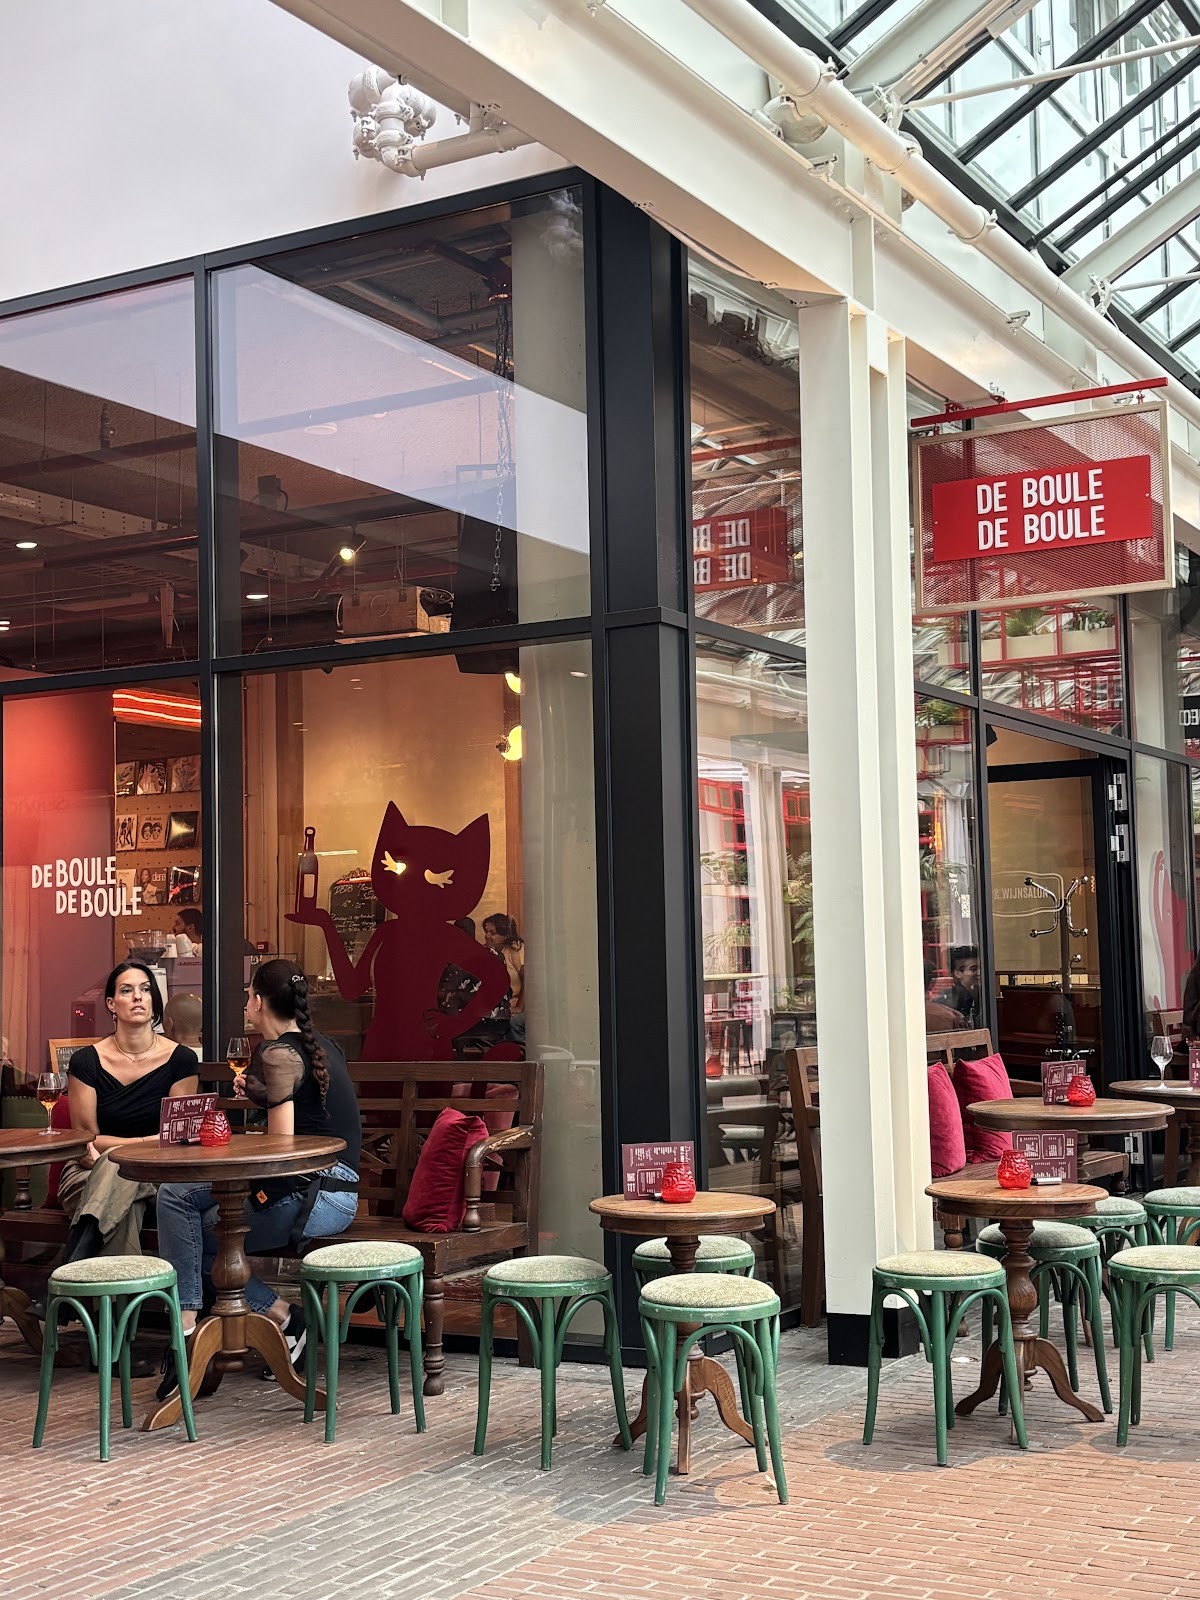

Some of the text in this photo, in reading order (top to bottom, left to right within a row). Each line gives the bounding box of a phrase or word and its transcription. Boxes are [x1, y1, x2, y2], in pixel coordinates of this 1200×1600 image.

[977, 468, 1103, 514] DE BOULE
[978, 505, 1105, 550] DE BOULE
[31, 856, 117, 889] DE BOULE
[56, 886, 142, 918] DE BOULE
